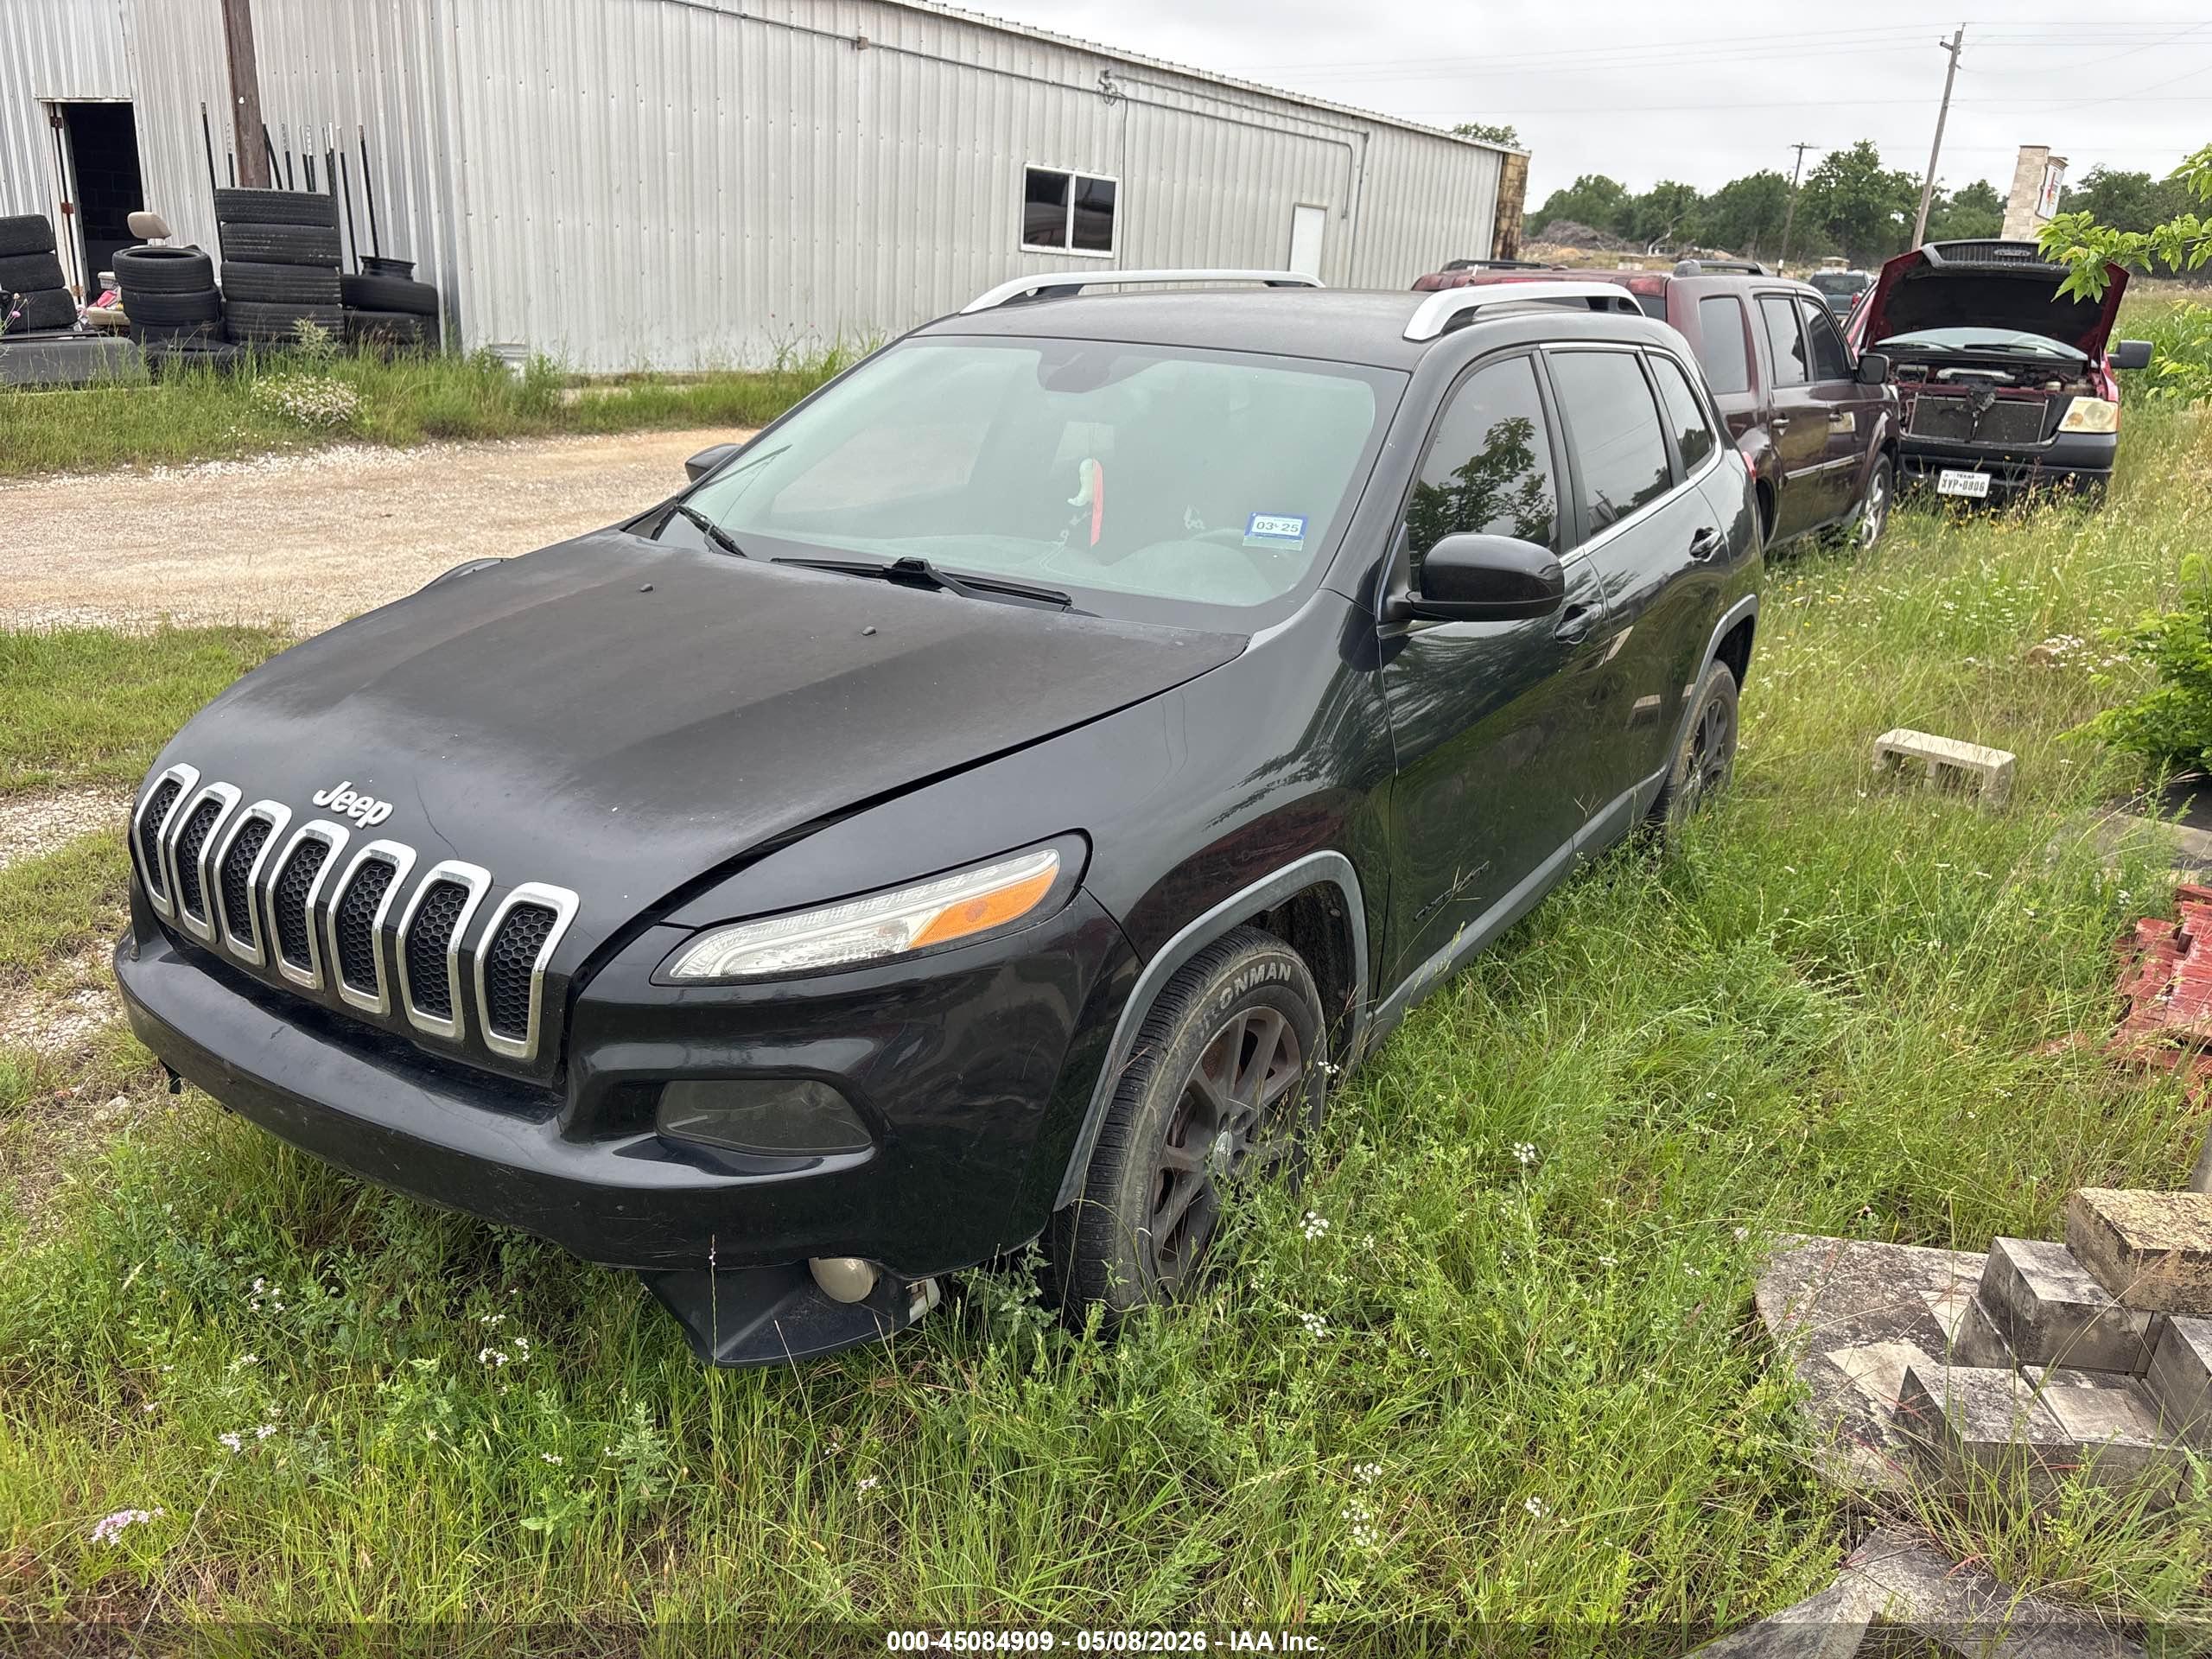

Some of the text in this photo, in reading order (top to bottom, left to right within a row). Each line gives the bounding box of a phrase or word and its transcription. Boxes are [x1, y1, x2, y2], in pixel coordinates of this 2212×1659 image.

[1255, 521, 1274, 531] 03
[1280, 523, 1300, 533] 25
[312, 780, 394, 829] Jeep
